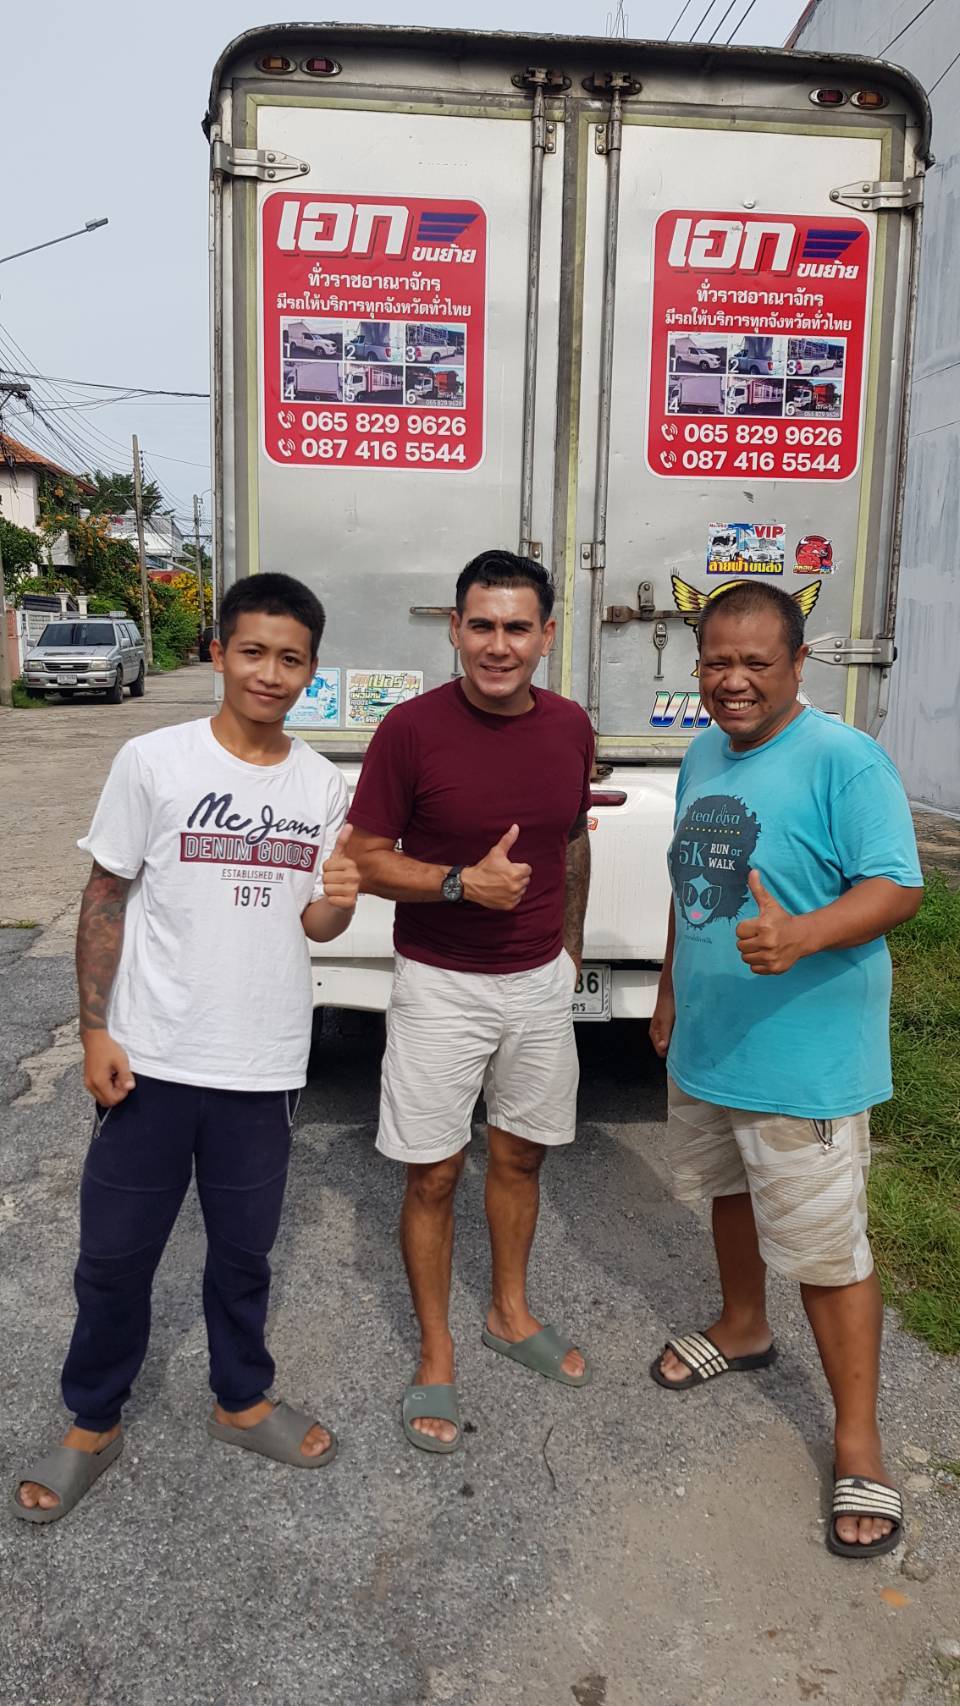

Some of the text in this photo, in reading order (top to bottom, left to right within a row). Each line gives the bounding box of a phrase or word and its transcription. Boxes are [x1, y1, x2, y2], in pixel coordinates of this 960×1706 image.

[276, 200, 411, 256] เอก
[411, 243, 477, 264] ขนย้าย
[667, 218, 797, 272] เอก
[308, 262, 441, 292] ทั่วราชอาณาจักร
[797, 260, 859, 279] ขนย้าย
[696, 278, 824, 307] ทั่วราชอาณาจักร
[664, 307, 852, 334] มีรถให้บริการทุกจังหวัดทั่วไทย
[284, 343, 292, 358] 1
[346, 345, 356, 360] 2
[405, 346, 416, 362] 3
[670, 357, 677, 372] 1
[729, 359, 740, 374] 2
[786, 360, 797, 375] 3
[284, 386, 296, 400] 4
[346, 387, 355, 402] 5
[406, 388, 416, 404] 6
[668, 398, 680, 413] 4
[727, 400, 737, 415] 5
[785, 401, 795, 416] 6
[301, 411, 467, 436] 065 829 9626
[684, 423, 842, 446] 065 829 9626
[301, 438, 467, 463] 087 416 5544
[682, 450, 841, 472] 087 416 5544
[754, 525, 784, 539] VIP
[187, 791, 321, 845] Mc Jeans
[691, 804, 740, 827] teal diva
[185, 836, 313, 868] DENIM GOODS
[679, 840, 742, 867] 5K RUN or
[708, 857, 735, 871] WALK
[221, 868, 284, 880] ESTABLISHED IN
[233, 885, 271, 907] 1975
